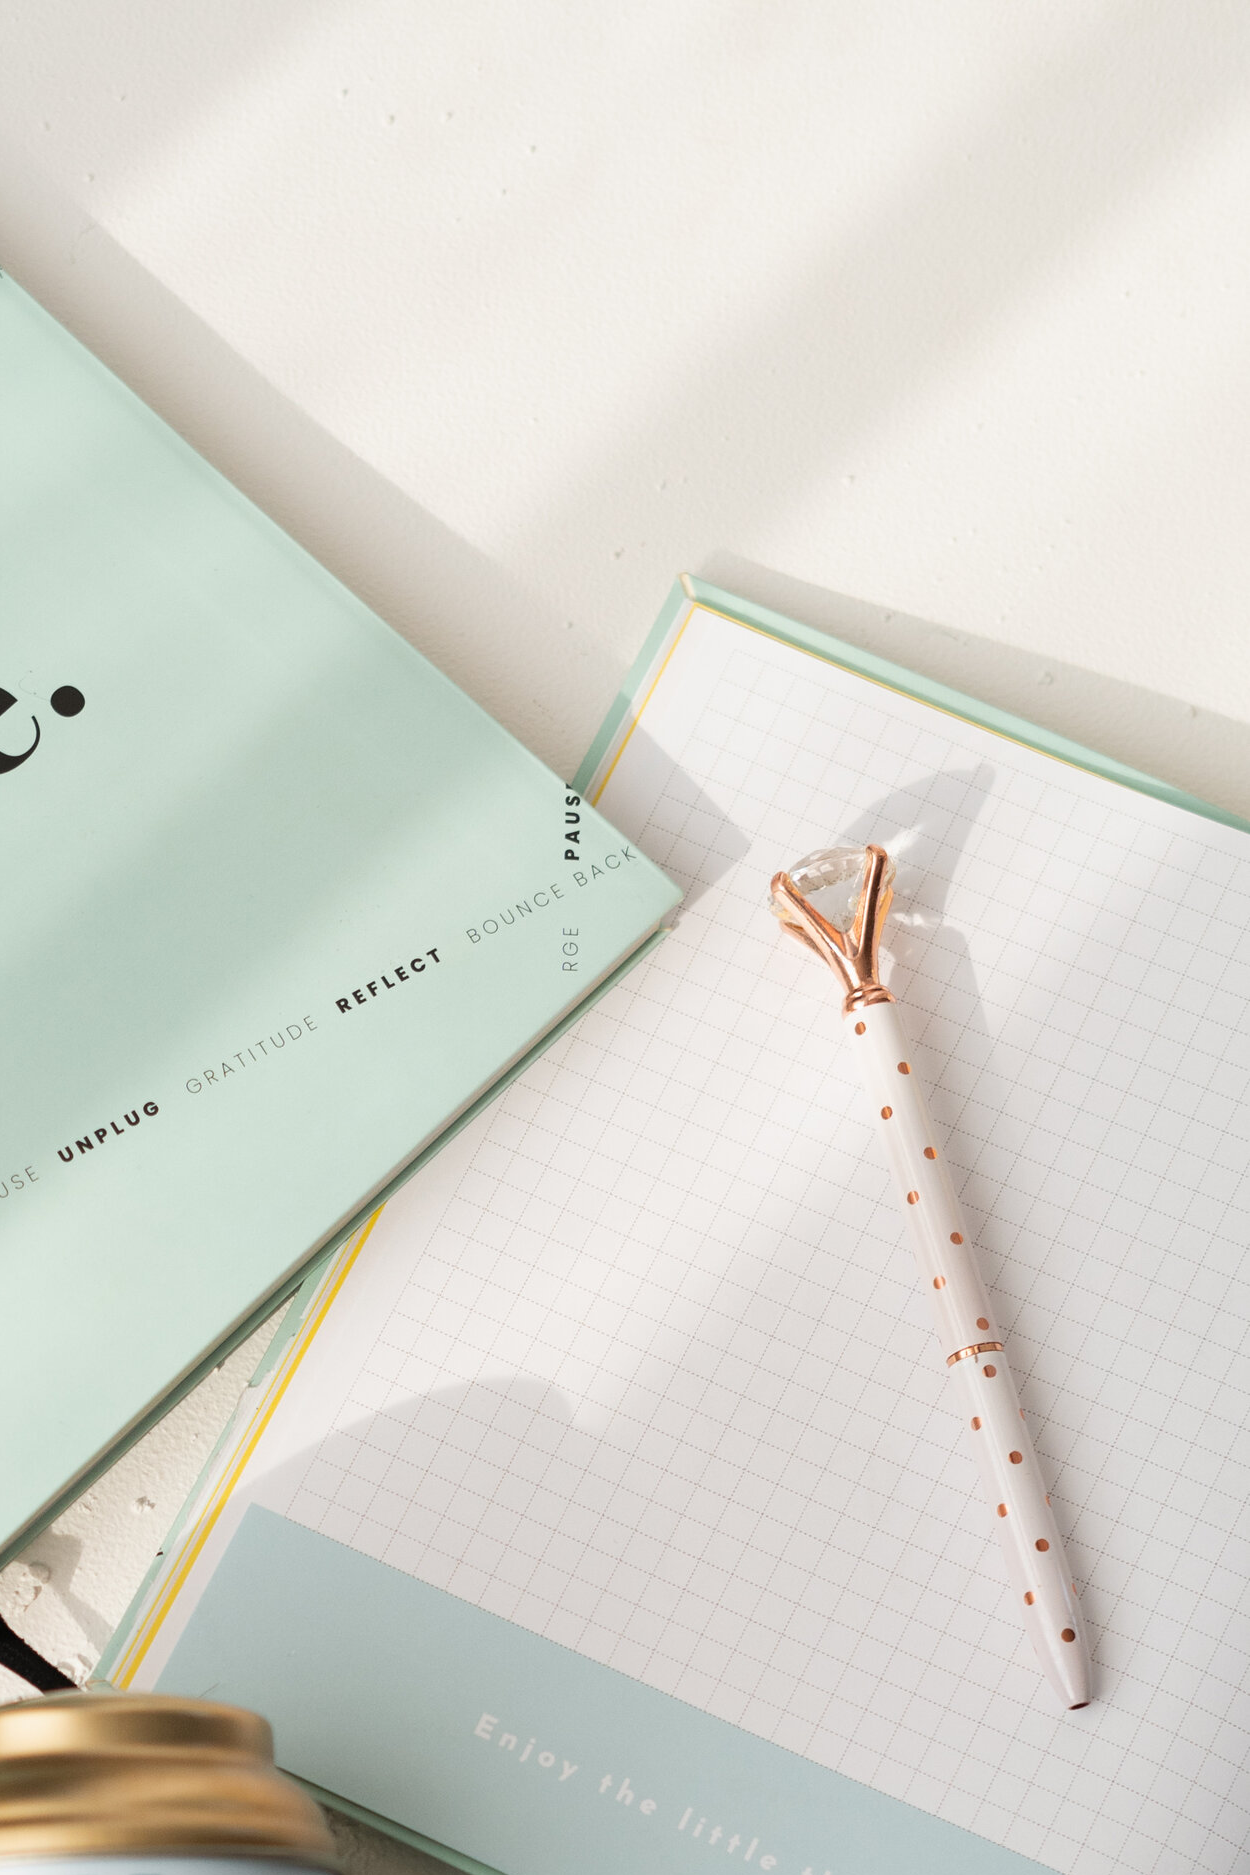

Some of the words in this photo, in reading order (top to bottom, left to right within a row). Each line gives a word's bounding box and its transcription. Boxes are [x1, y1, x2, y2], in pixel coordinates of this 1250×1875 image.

[564, 783, 581, 860] PAUS
[56, 1099, 160, 1163] UNPLUG
[185, 1015, 319, 1095] GRATITUDE
[335, 947, 443, 1015] REFLECT
[466, 883, 565, 944] BOUNCE
[572, 846, 638, 887] BACK
[561, 927, 579, 972] RGE
[474, 1712, 580, 1781] Enjoy
[598, 1772, 658, 1816] the
[677, 1806, 778, 1872] little
